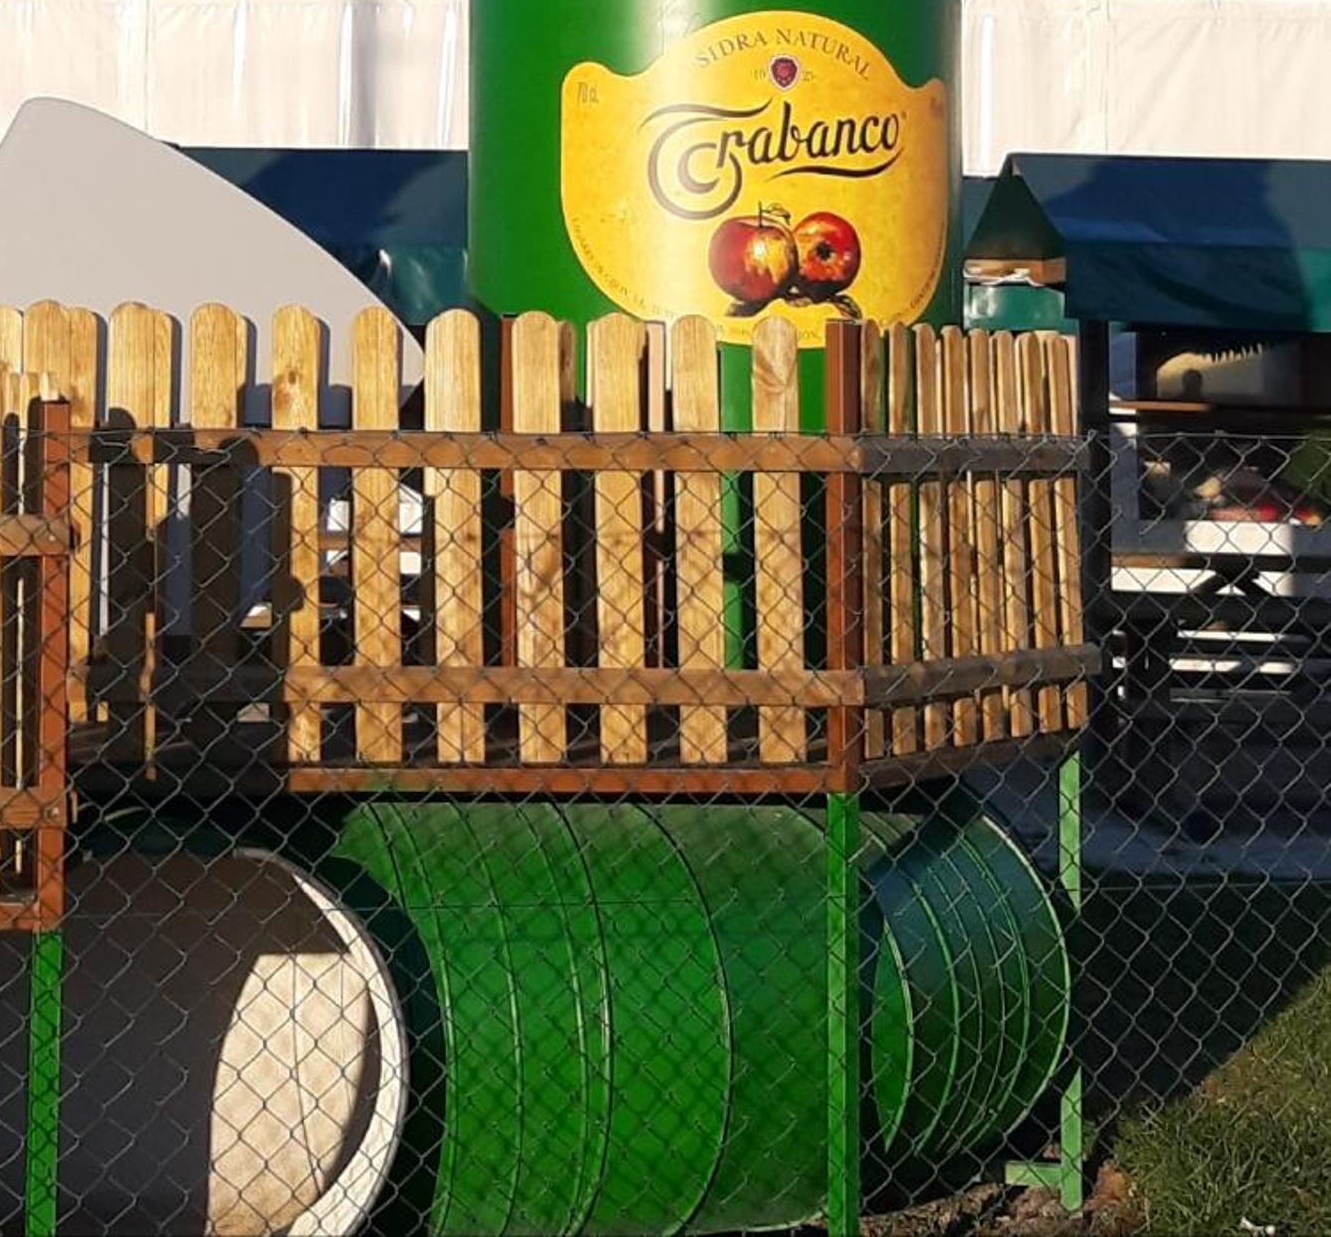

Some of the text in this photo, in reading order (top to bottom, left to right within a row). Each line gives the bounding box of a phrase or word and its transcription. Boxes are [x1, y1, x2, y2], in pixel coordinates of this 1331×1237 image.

[694, 28, 871, 81] SIDRA NATURAL
[638, 97, 902, 221] Trabanco
